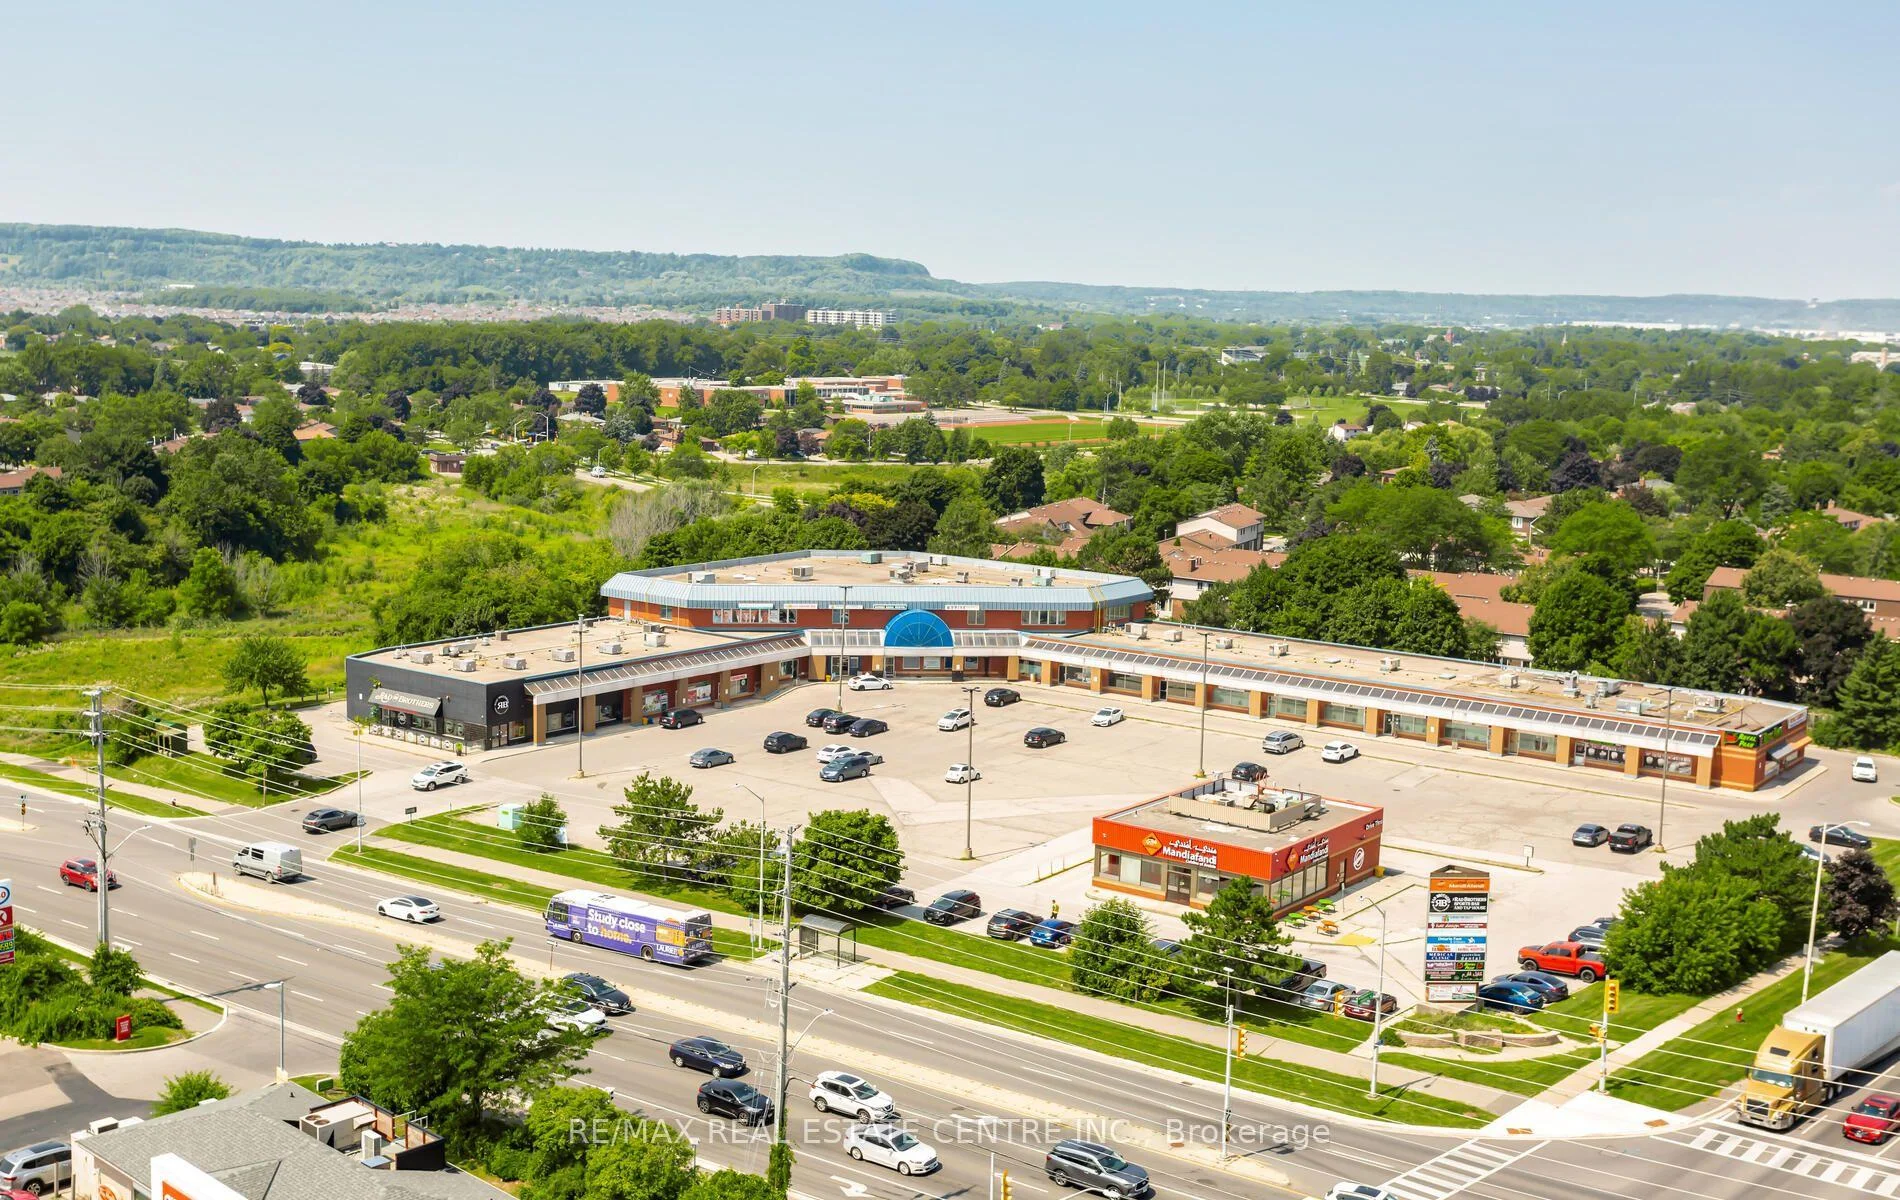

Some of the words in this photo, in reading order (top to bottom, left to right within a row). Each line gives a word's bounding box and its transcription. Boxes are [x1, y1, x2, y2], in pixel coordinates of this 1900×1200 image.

[398, 695, 435, 709] BROTHERS
[588, 909, 618, 929] Study
[619, 917, 646, 933] close
[587, 922, 599, 935] to
[600, 927, 632, 945] home.
